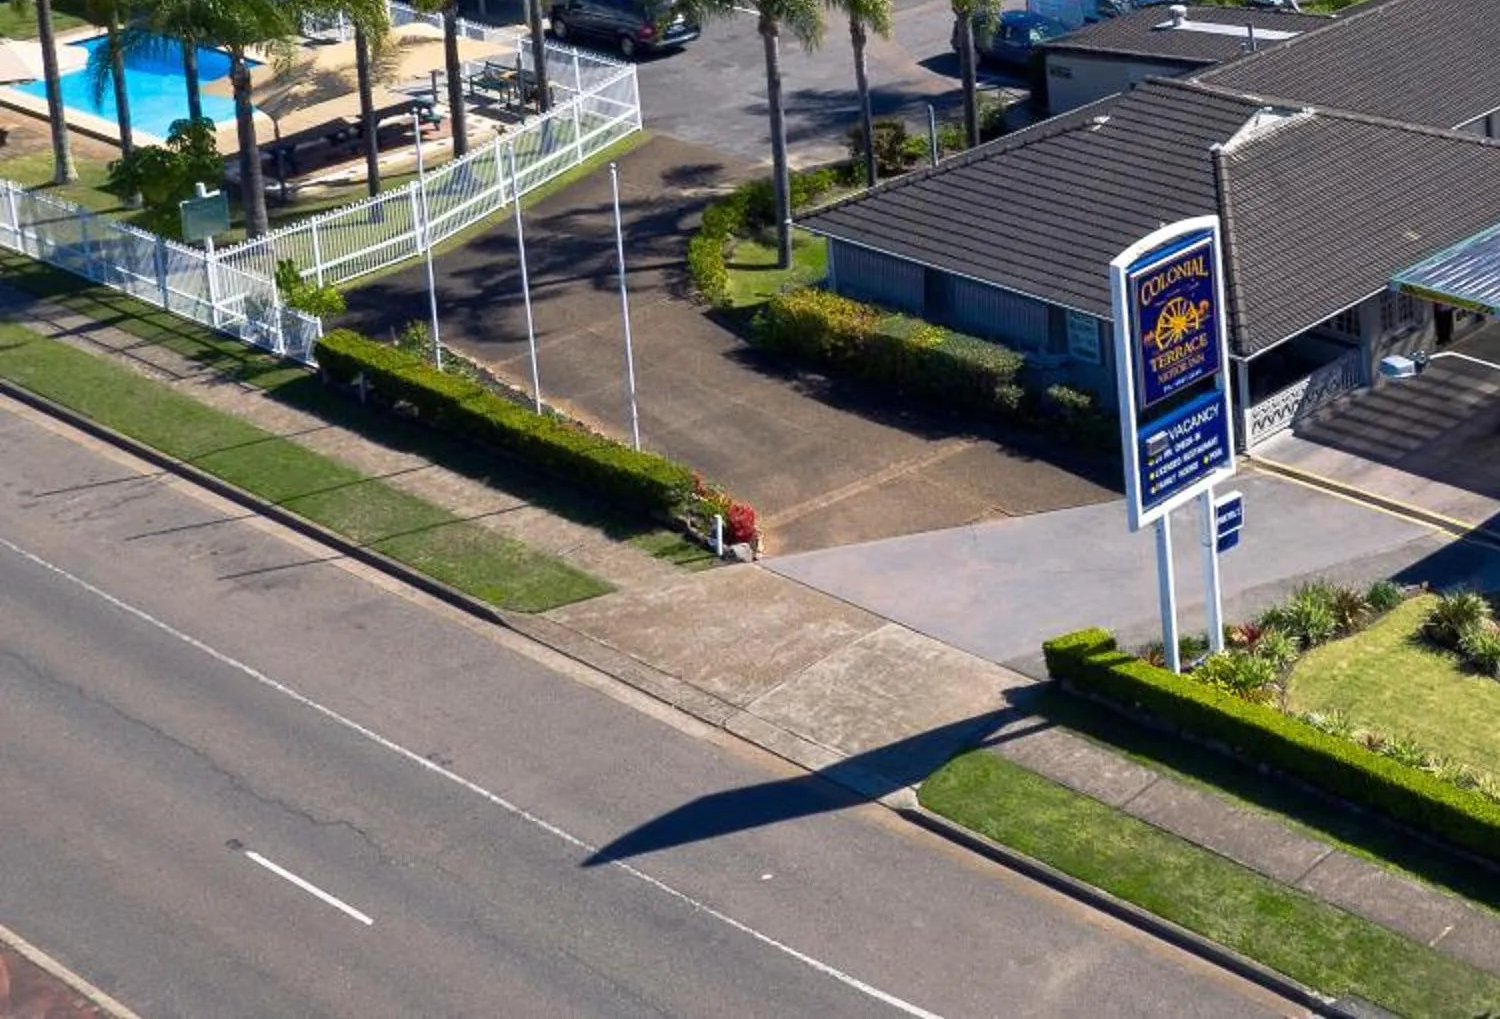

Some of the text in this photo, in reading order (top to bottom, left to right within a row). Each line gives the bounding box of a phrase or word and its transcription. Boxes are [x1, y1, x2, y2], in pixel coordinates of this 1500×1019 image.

[1141, 255, 1209, 306] COLONIAL
[1149, 332, 1208, 372] TERRACE
[1167, 402, 1220, 441] VACANCY
